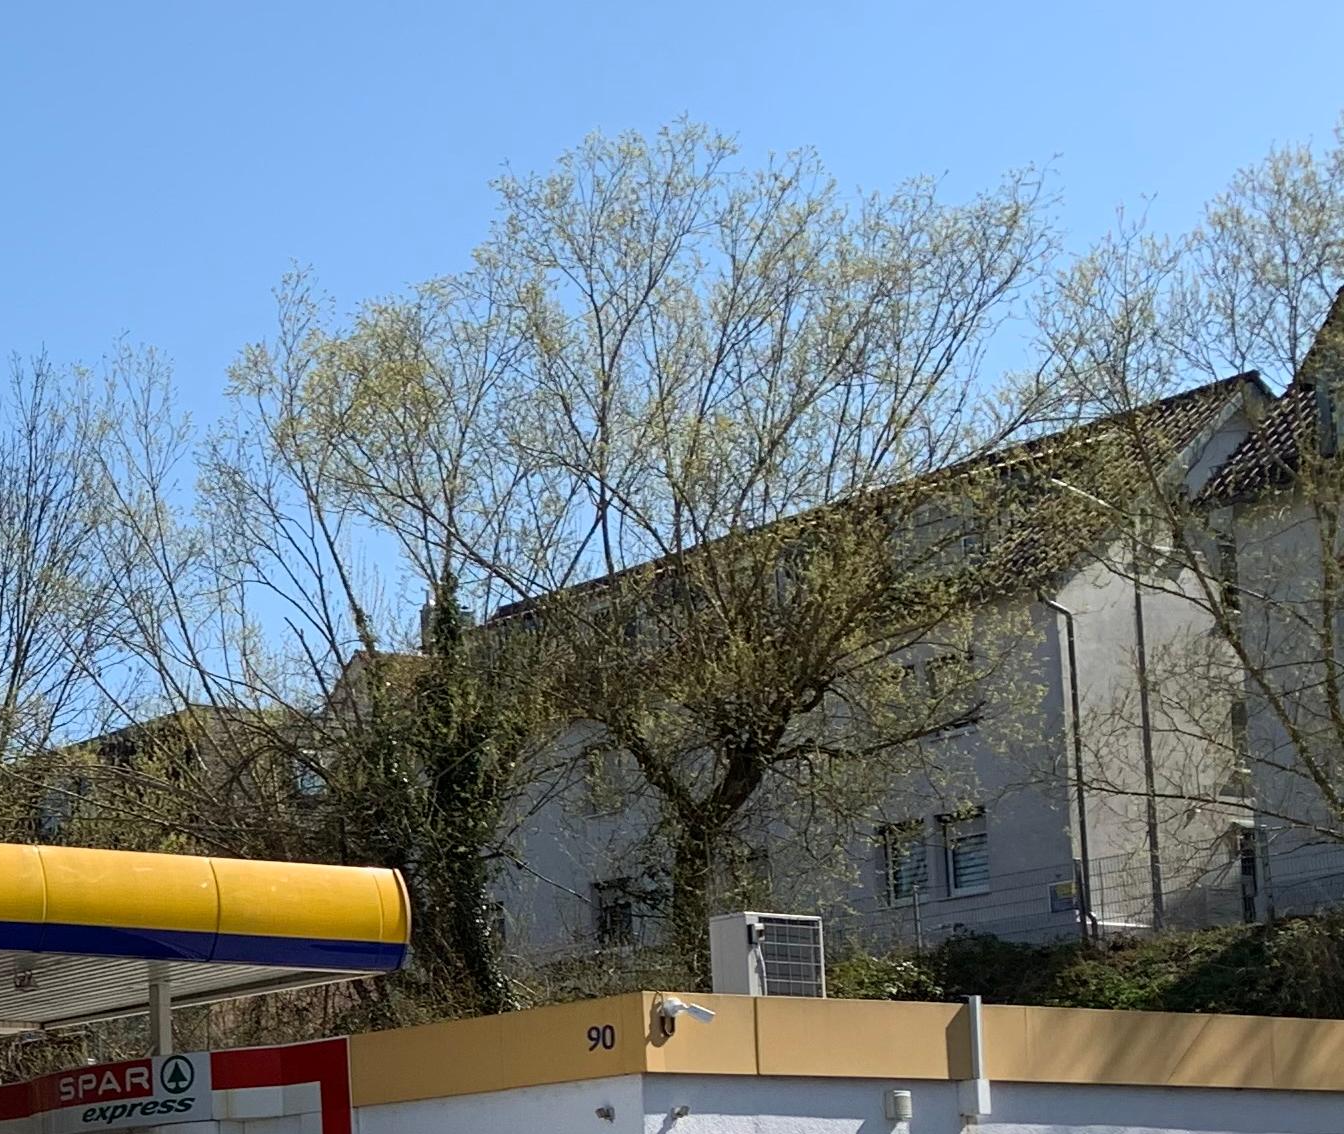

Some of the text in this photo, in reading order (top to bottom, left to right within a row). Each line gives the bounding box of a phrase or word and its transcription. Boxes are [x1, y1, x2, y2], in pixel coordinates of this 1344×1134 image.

[587, 1024, 615, 1052] 90
[59, 1066, 151, 1102] SPAR
[82, 1098, 196, 1124] express
